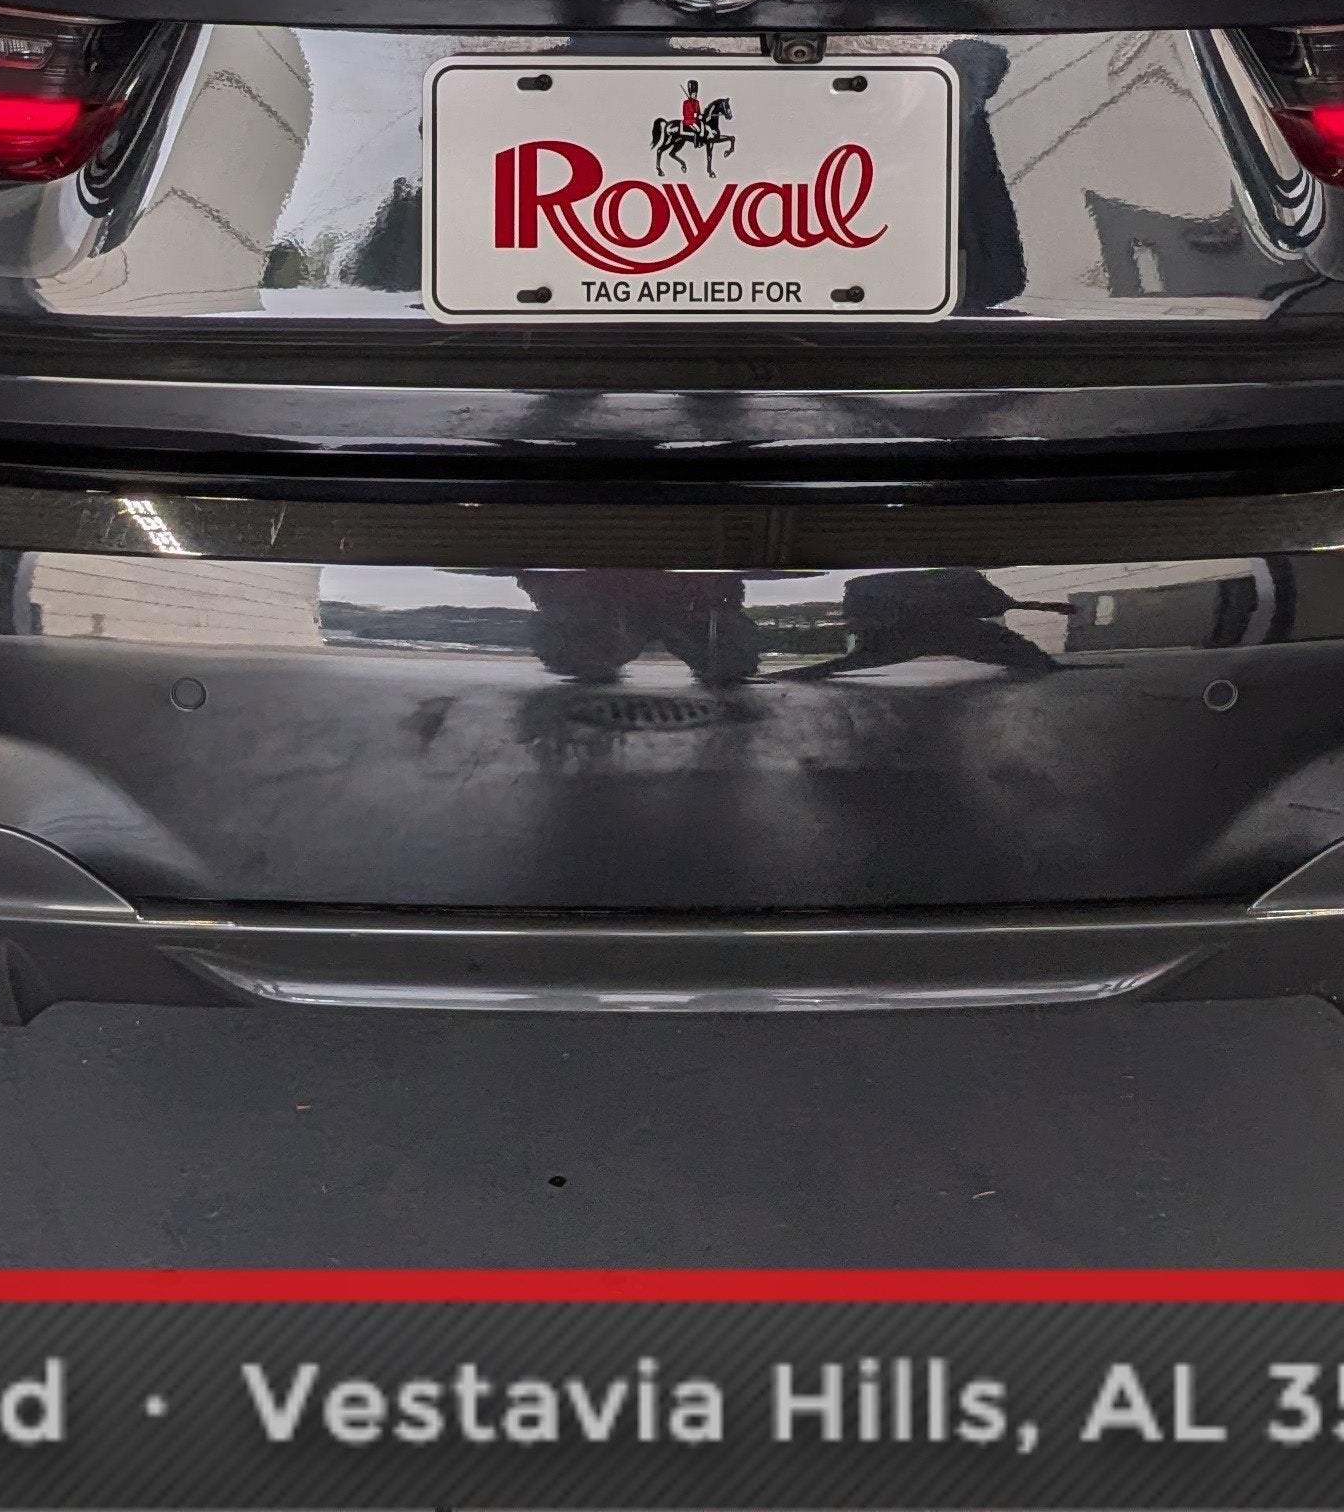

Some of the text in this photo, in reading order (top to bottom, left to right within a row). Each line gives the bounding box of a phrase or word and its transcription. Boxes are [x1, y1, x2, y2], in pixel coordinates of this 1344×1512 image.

[494, 140, 890, 275] Royal
[581, 281, 802, 304] TAG APPLIED FOR
